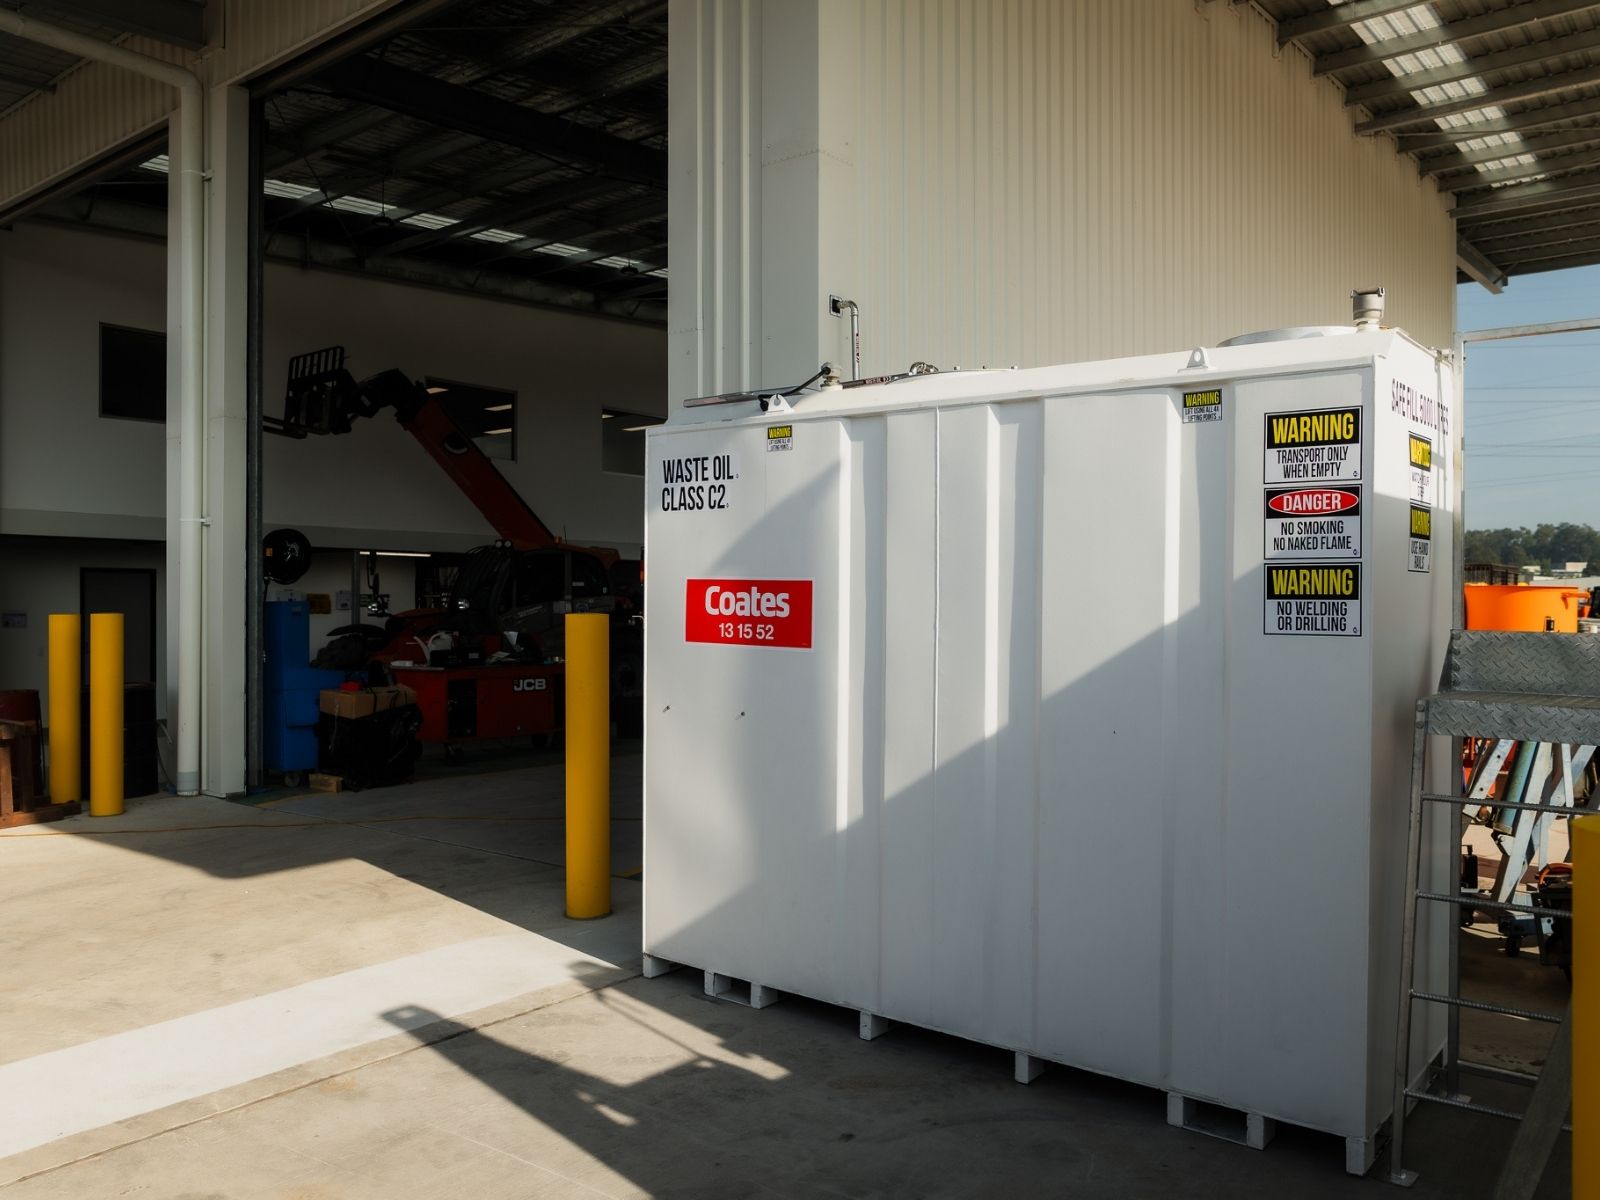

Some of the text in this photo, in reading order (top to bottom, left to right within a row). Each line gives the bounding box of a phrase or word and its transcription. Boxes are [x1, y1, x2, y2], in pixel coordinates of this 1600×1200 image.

[1186, 392, 1219, 406] WARNING
[769, 427, 790, 438] WARNING
[1273, 413, 1354, 444] WARNING
[1277, 446, 1348, 463] TRANSPORT ONLY
[663, 455, 733, 483] WASTE OIL
[1283, 462, 1341, 479] WHEN EMPTY
[662, 484, 726, 511] CLASS C2
[1283, 493, 1341, 512] DANGER
[1281, 521, 1344, 535] NO SMOKING
[1273, 536, 1352, 550] NO NAKED FLAME
[1272, 569, 1353, 595] WARNING
[705, 586, 790, 617] Coates
[1277, 602, 1347, 616] NO WELDING
[719, 623, 774, 639] 13 15 52
[1278, 617, 1347, 631] OR DRILLING
[513, 679, 546, 691] JCB
